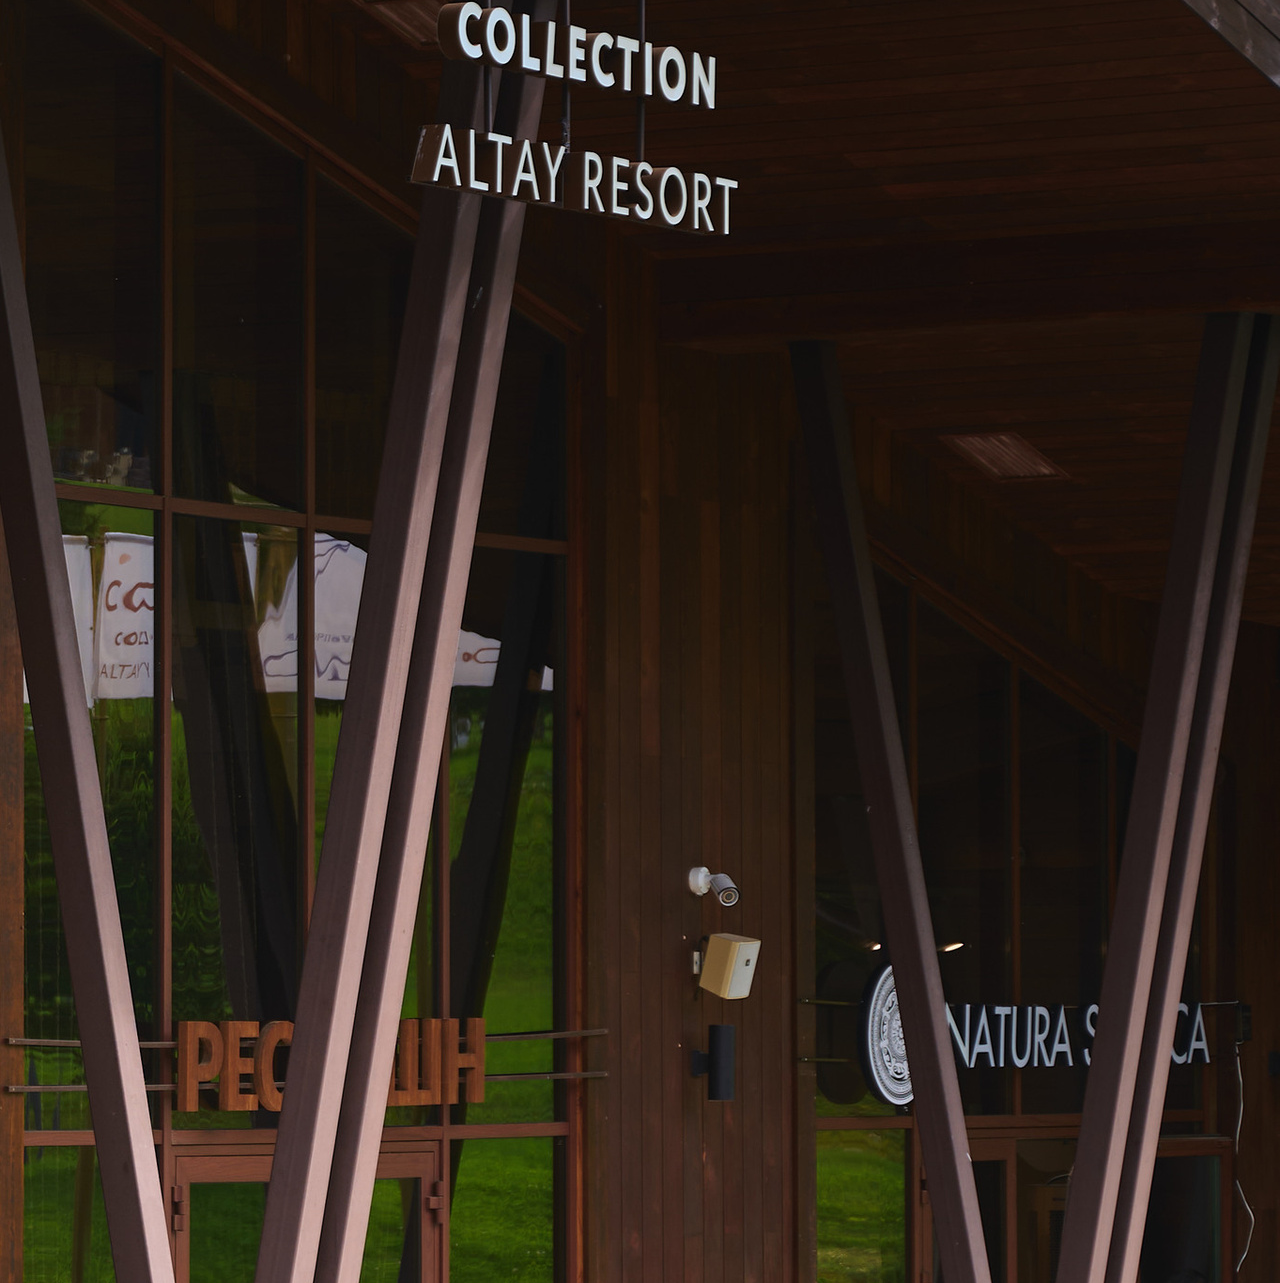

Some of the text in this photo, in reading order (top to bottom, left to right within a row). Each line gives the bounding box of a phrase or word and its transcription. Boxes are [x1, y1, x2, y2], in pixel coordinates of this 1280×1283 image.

[458, 1, 717, 110] COLLECTION
[432, 123, 739, 235] ALTAY RESORT
[944, 1001, 1074, 1068] NATURA
